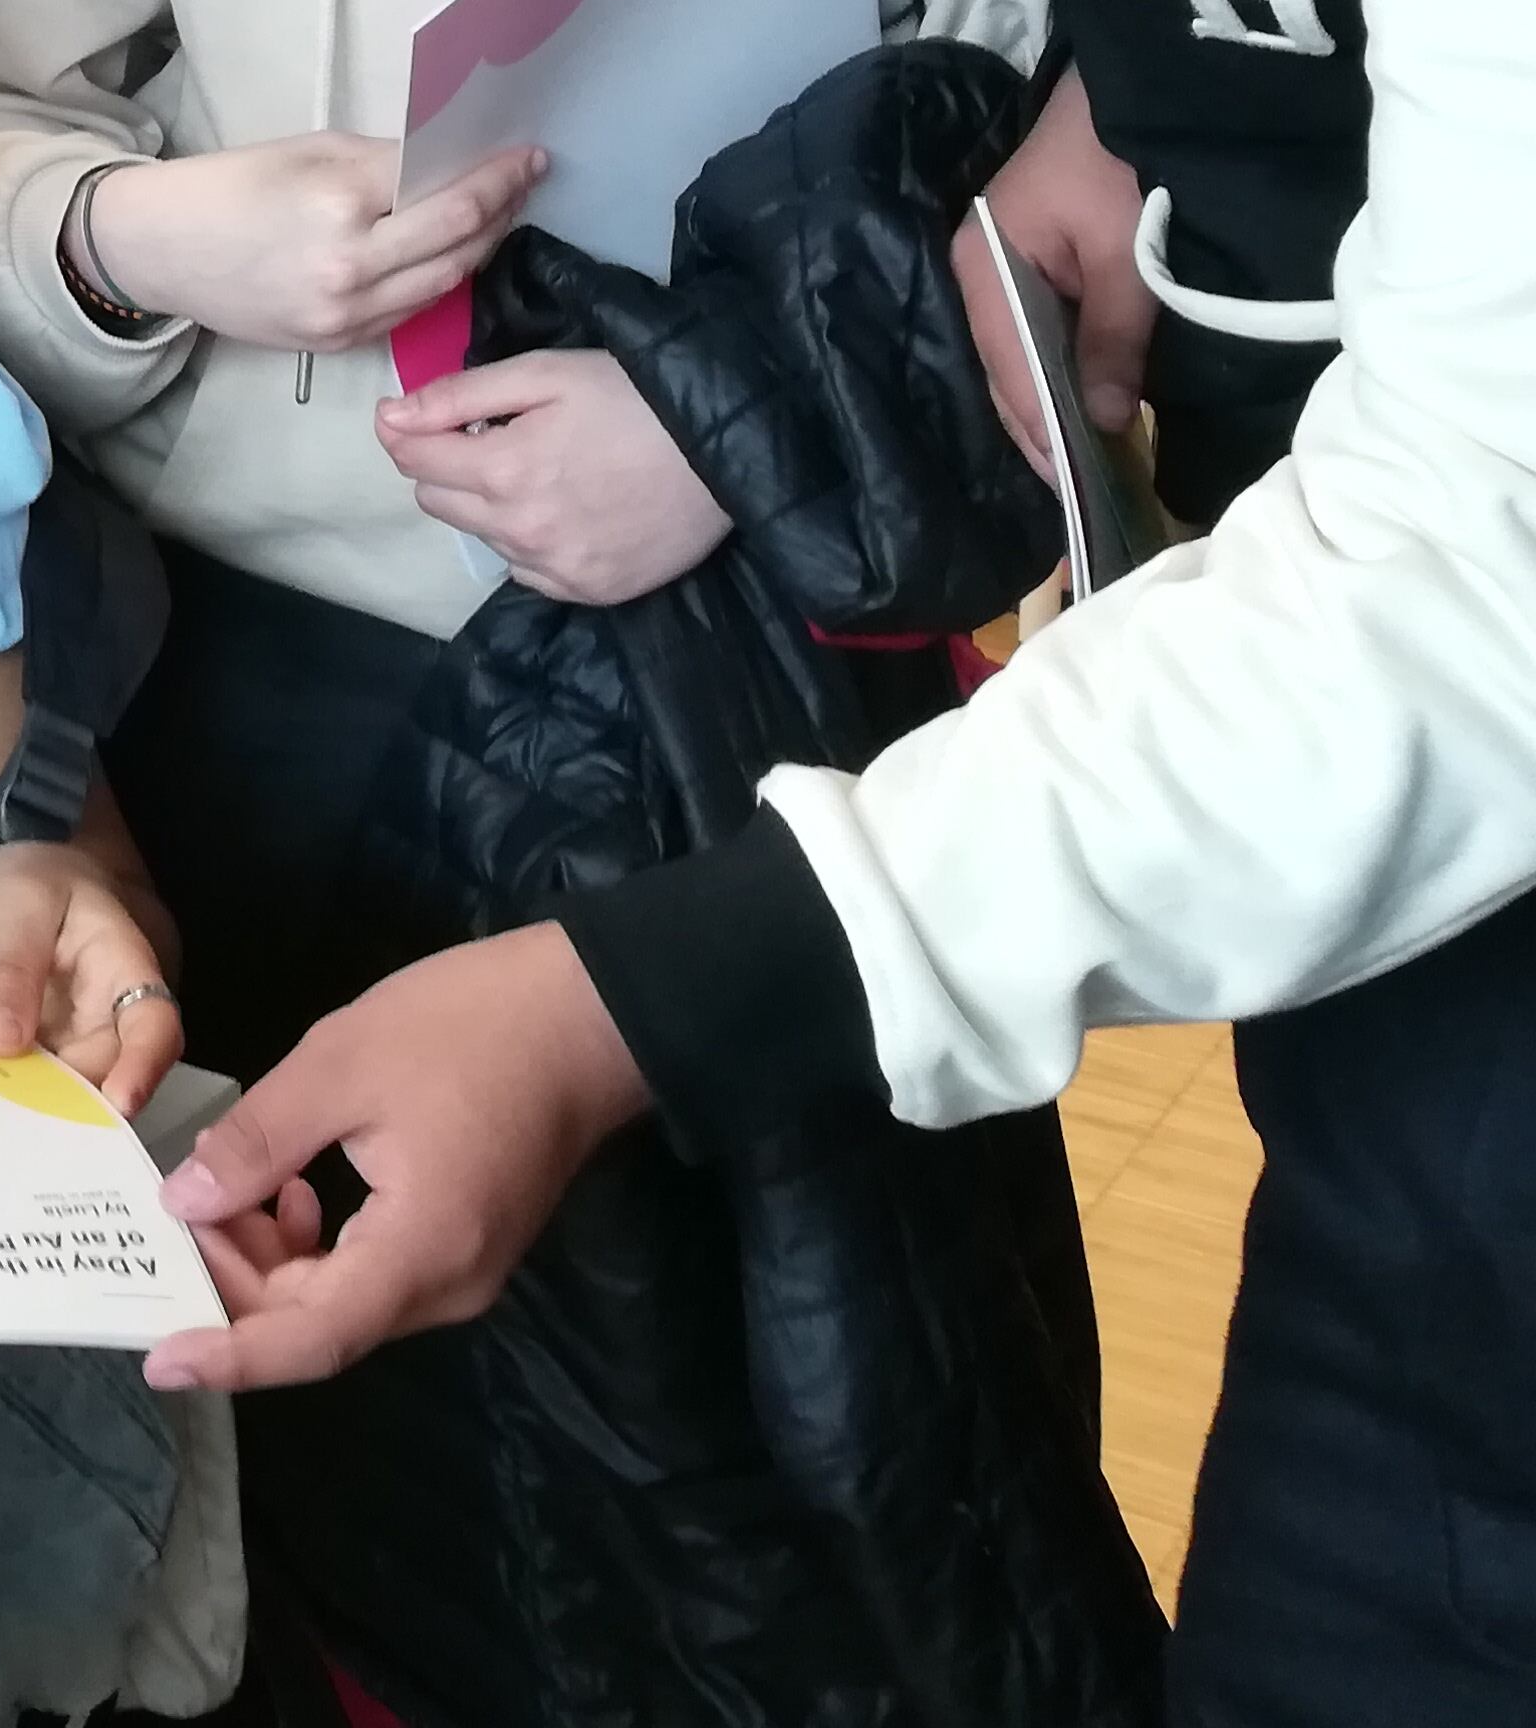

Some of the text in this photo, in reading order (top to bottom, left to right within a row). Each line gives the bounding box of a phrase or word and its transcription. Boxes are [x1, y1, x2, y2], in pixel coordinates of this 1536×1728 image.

[21, 1231, 62, 1250] Au
[35, 1255, 68, 1276] in
[73, 1250, 132, 1277] Day
